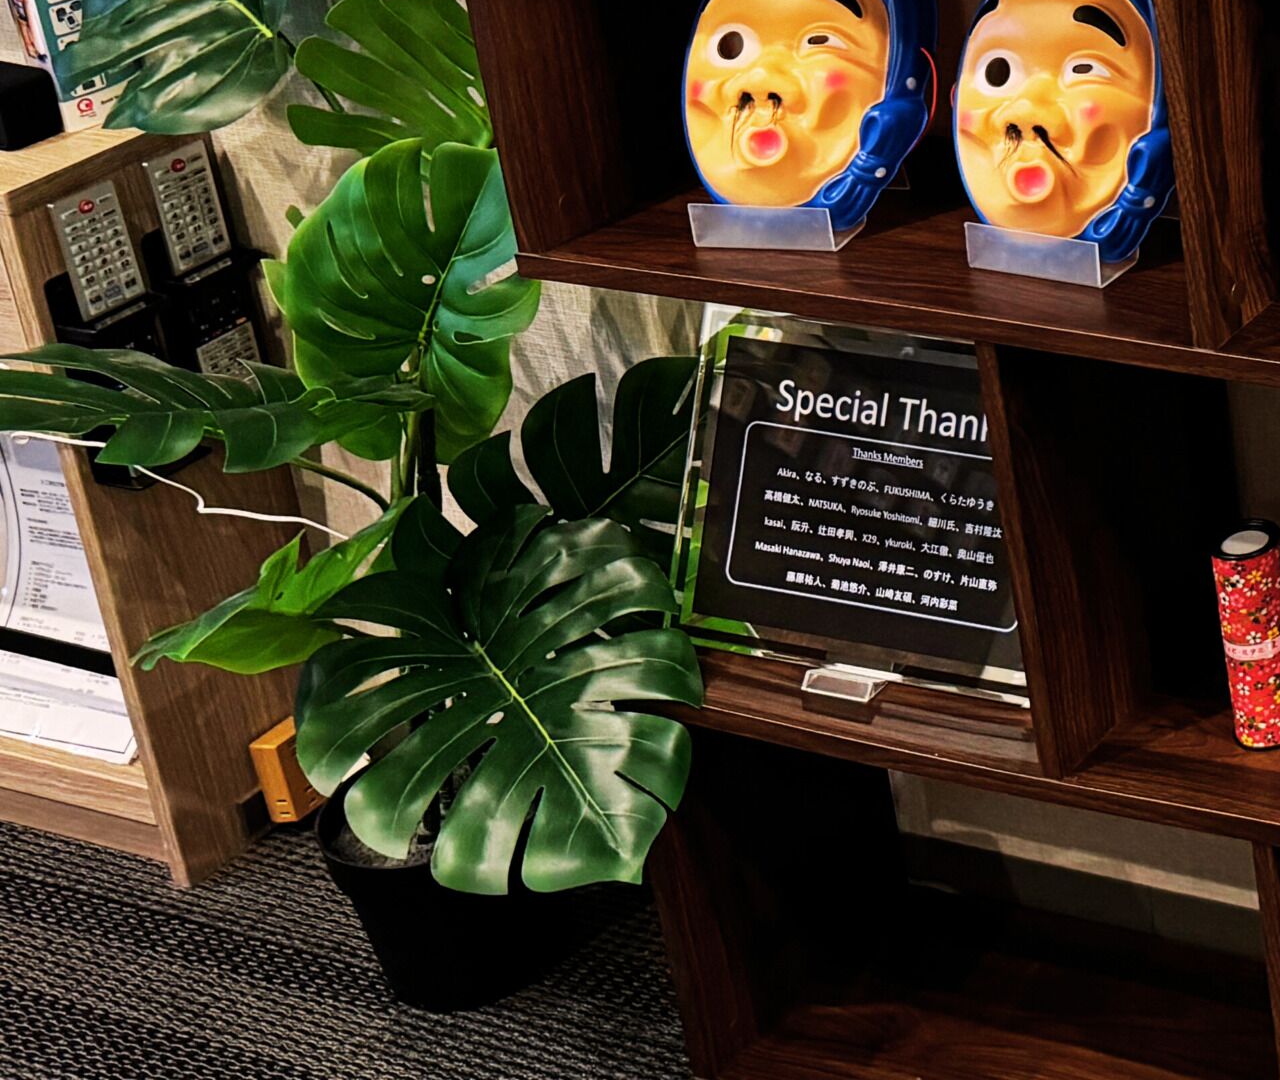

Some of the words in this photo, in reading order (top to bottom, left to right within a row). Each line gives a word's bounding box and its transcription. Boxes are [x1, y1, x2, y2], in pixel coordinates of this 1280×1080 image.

[775, 379, 890, 428] Special
[852, 447, 883, 462] Thanks
[883, 452, 924, 469] Members
